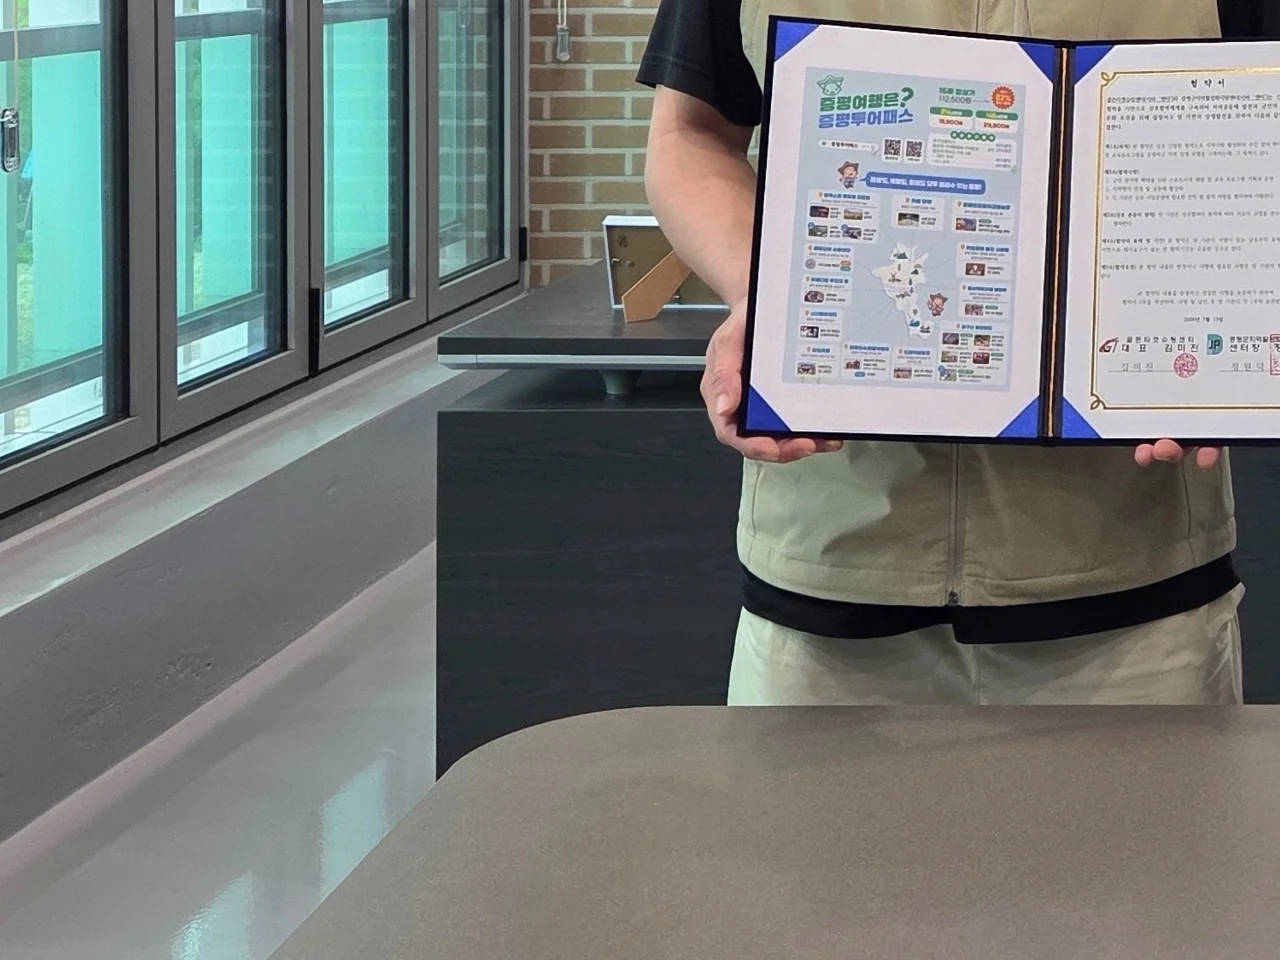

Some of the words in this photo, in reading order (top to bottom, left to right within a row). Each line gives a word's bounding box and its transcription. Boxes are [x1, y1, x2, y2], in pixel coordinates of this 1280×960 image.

[820, 86, 914, 112] 증평여행은?
[940, 95, 972, 104] 112,500원
[818, 109, 914, 128] 증평투어패스
[1165, 344, 1198, 352] 김미진
[1230, 344, 1260, 352] 센터장
